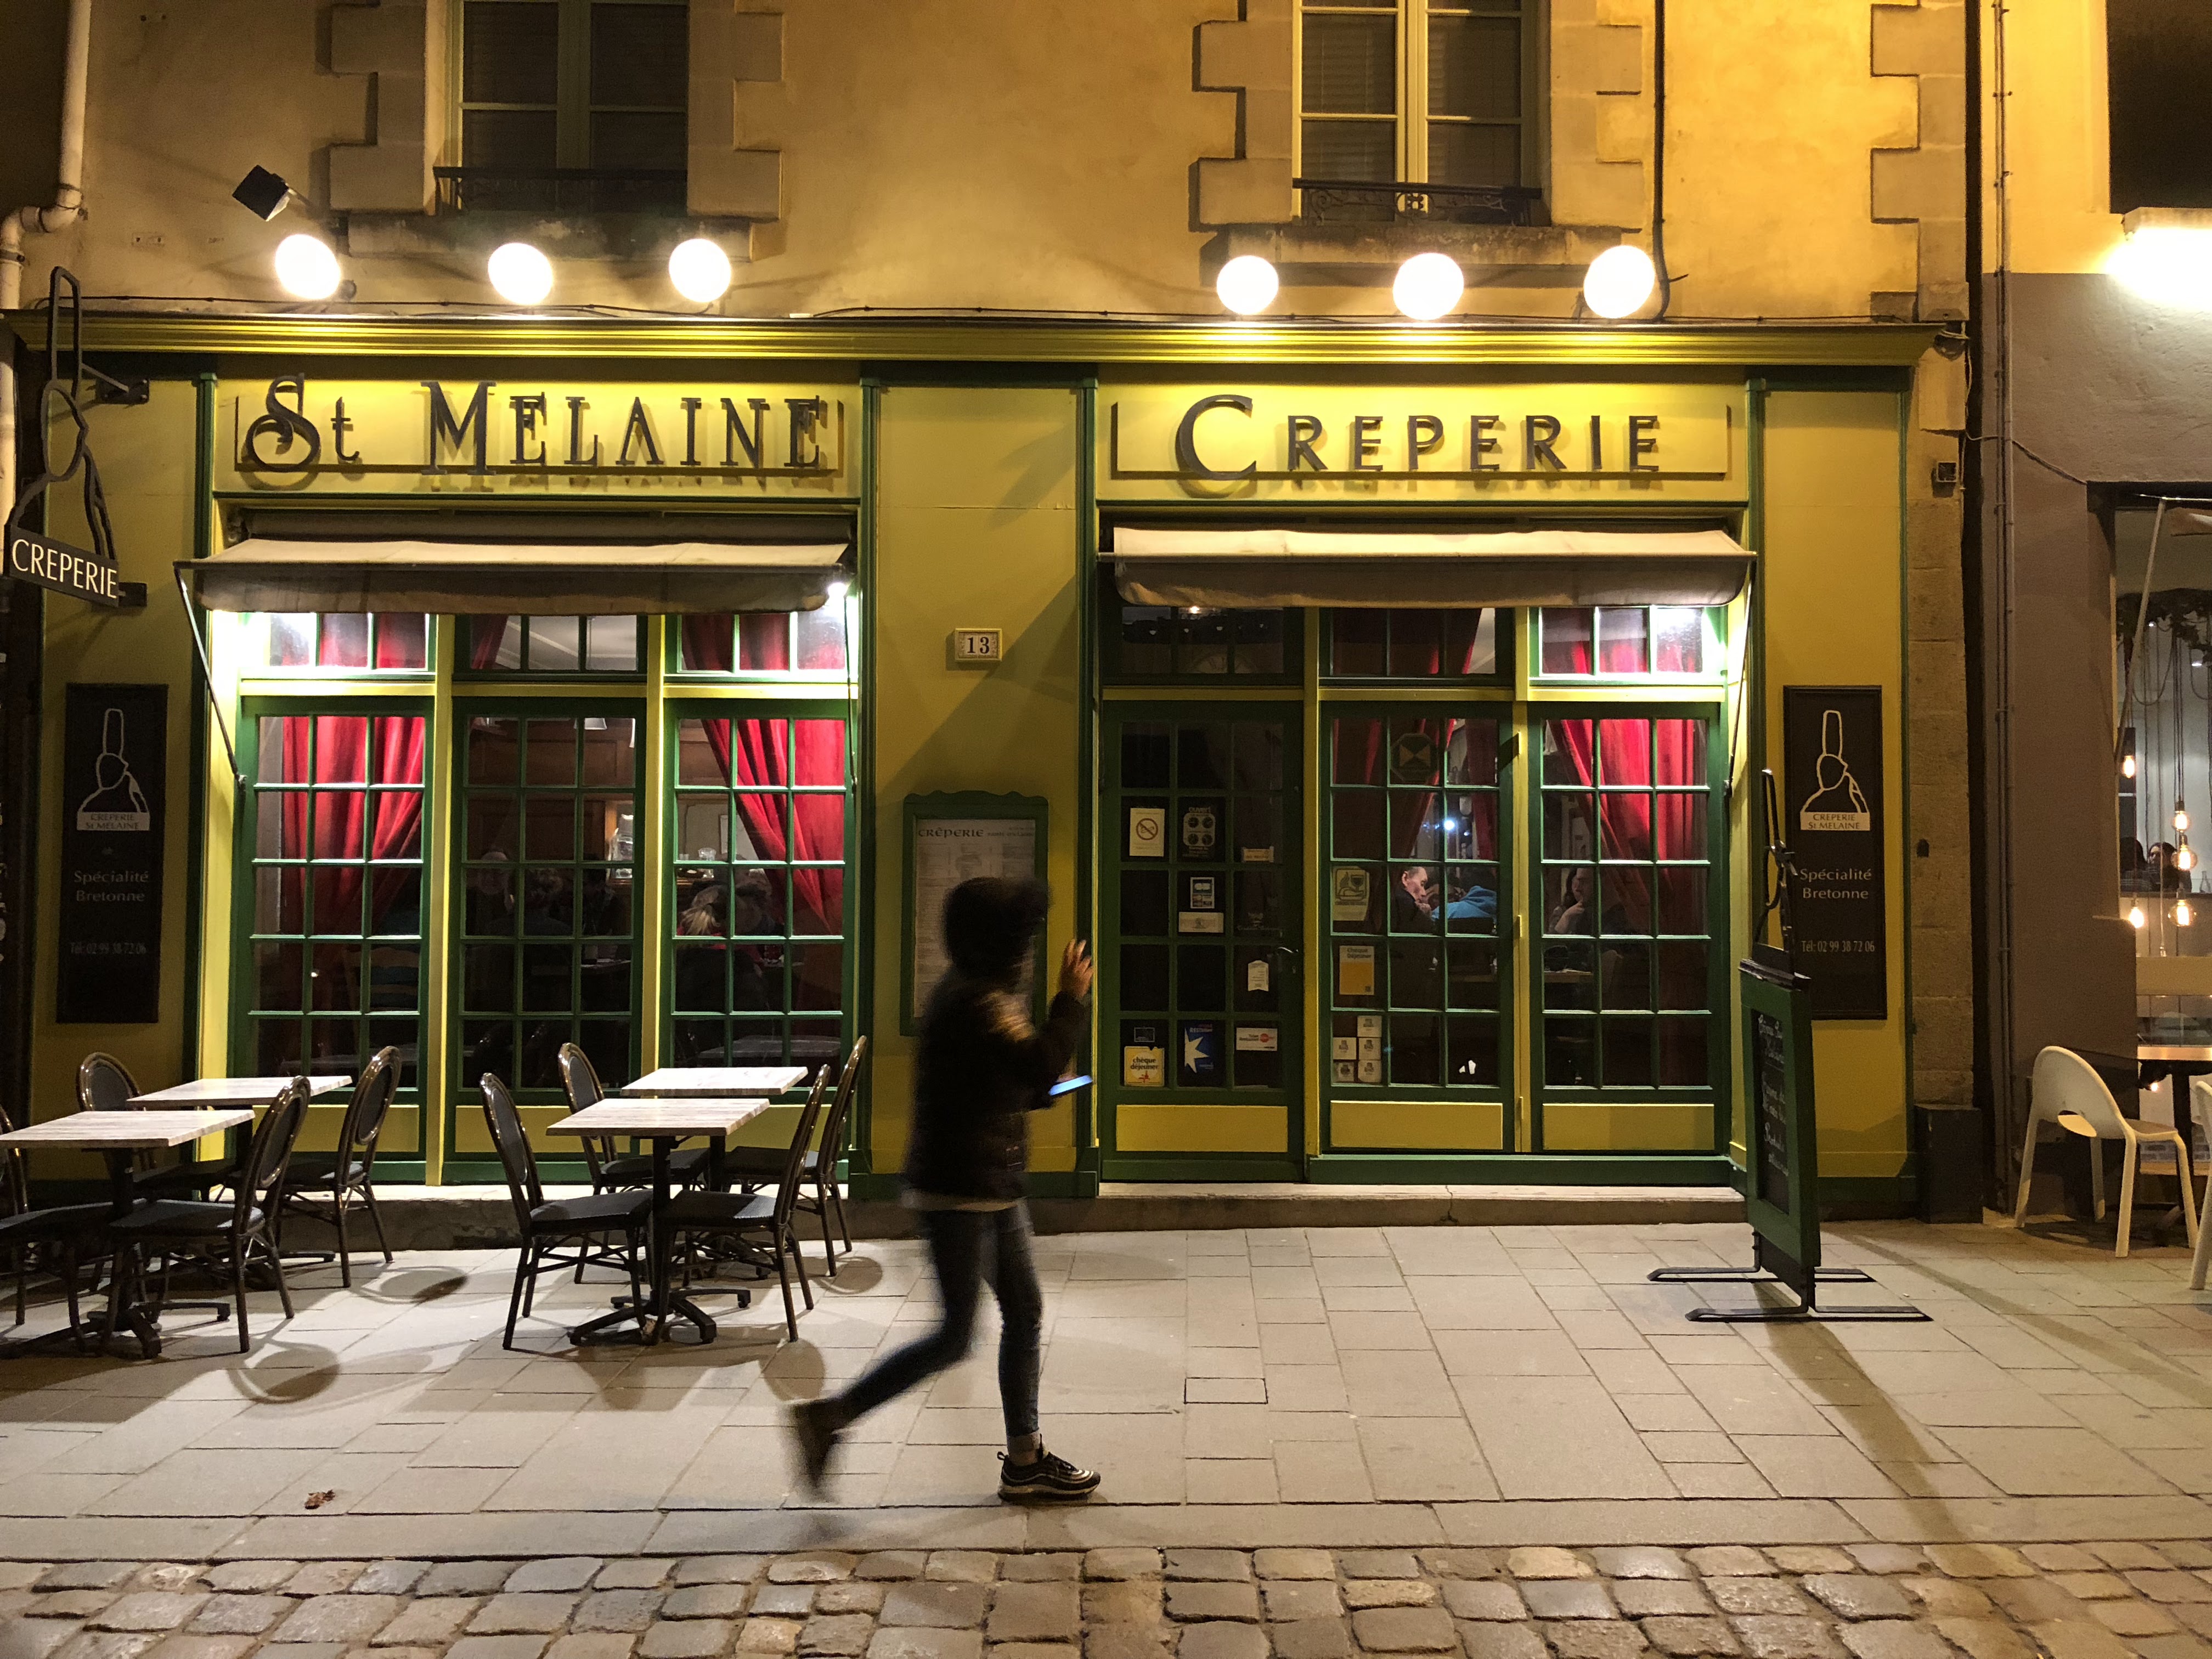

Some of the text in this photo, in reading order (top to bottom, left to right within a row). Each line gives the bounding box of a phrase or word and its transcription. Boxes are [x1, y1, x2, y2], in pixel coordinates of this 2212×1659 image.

[246, 374, 820, 476] St MELAINE
[1175, 394, 1659, 481] CREPERIE
[12, 539, 117, 599] CREPERIE
[967, 636, 990, 654] 13
[91, 813, 135, 821] CREPERIE
[74, 870, 149, 884] Spécialité
[1799, 868, 1872, 882] Spécialité
[76, 890, 145, 902] Bretonne
[1803, 887, 1869, 899] Bretonne
[1817, 941, 1827, 952] 02
[1830, 941, 1838, 952] 99
[1842, 940, 1851, 952] 38
[1853, 940, 1862, 952] 72
[1865, 940, 1875, 952] 06
